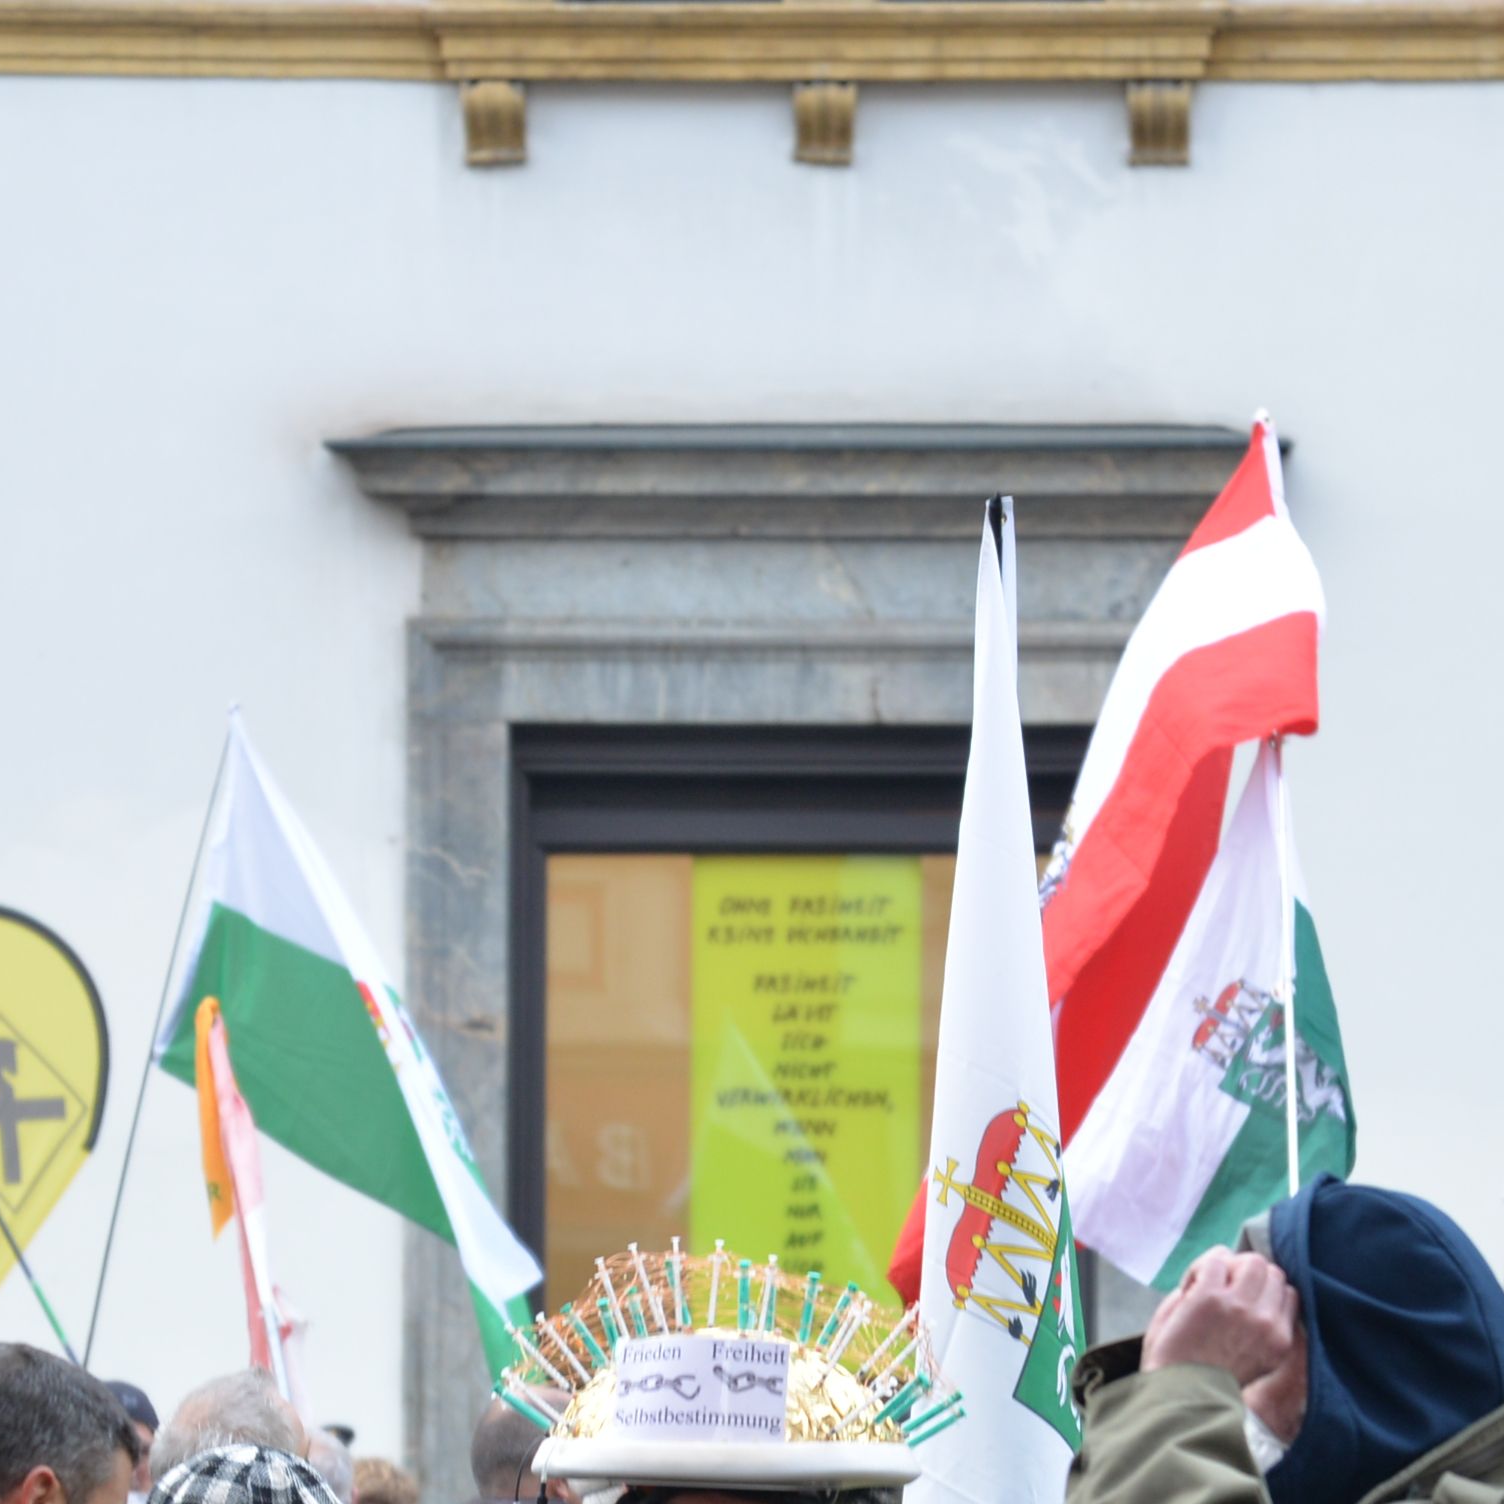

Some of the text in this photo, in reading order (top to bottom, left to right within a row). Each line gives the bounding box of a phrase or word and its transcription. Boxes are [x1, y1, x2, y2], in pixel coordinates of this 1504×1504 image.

[622, 1342, 786, 1366] Frieden Freiheit
[614, 1405, 783, 1435] Selbstbestimmung
